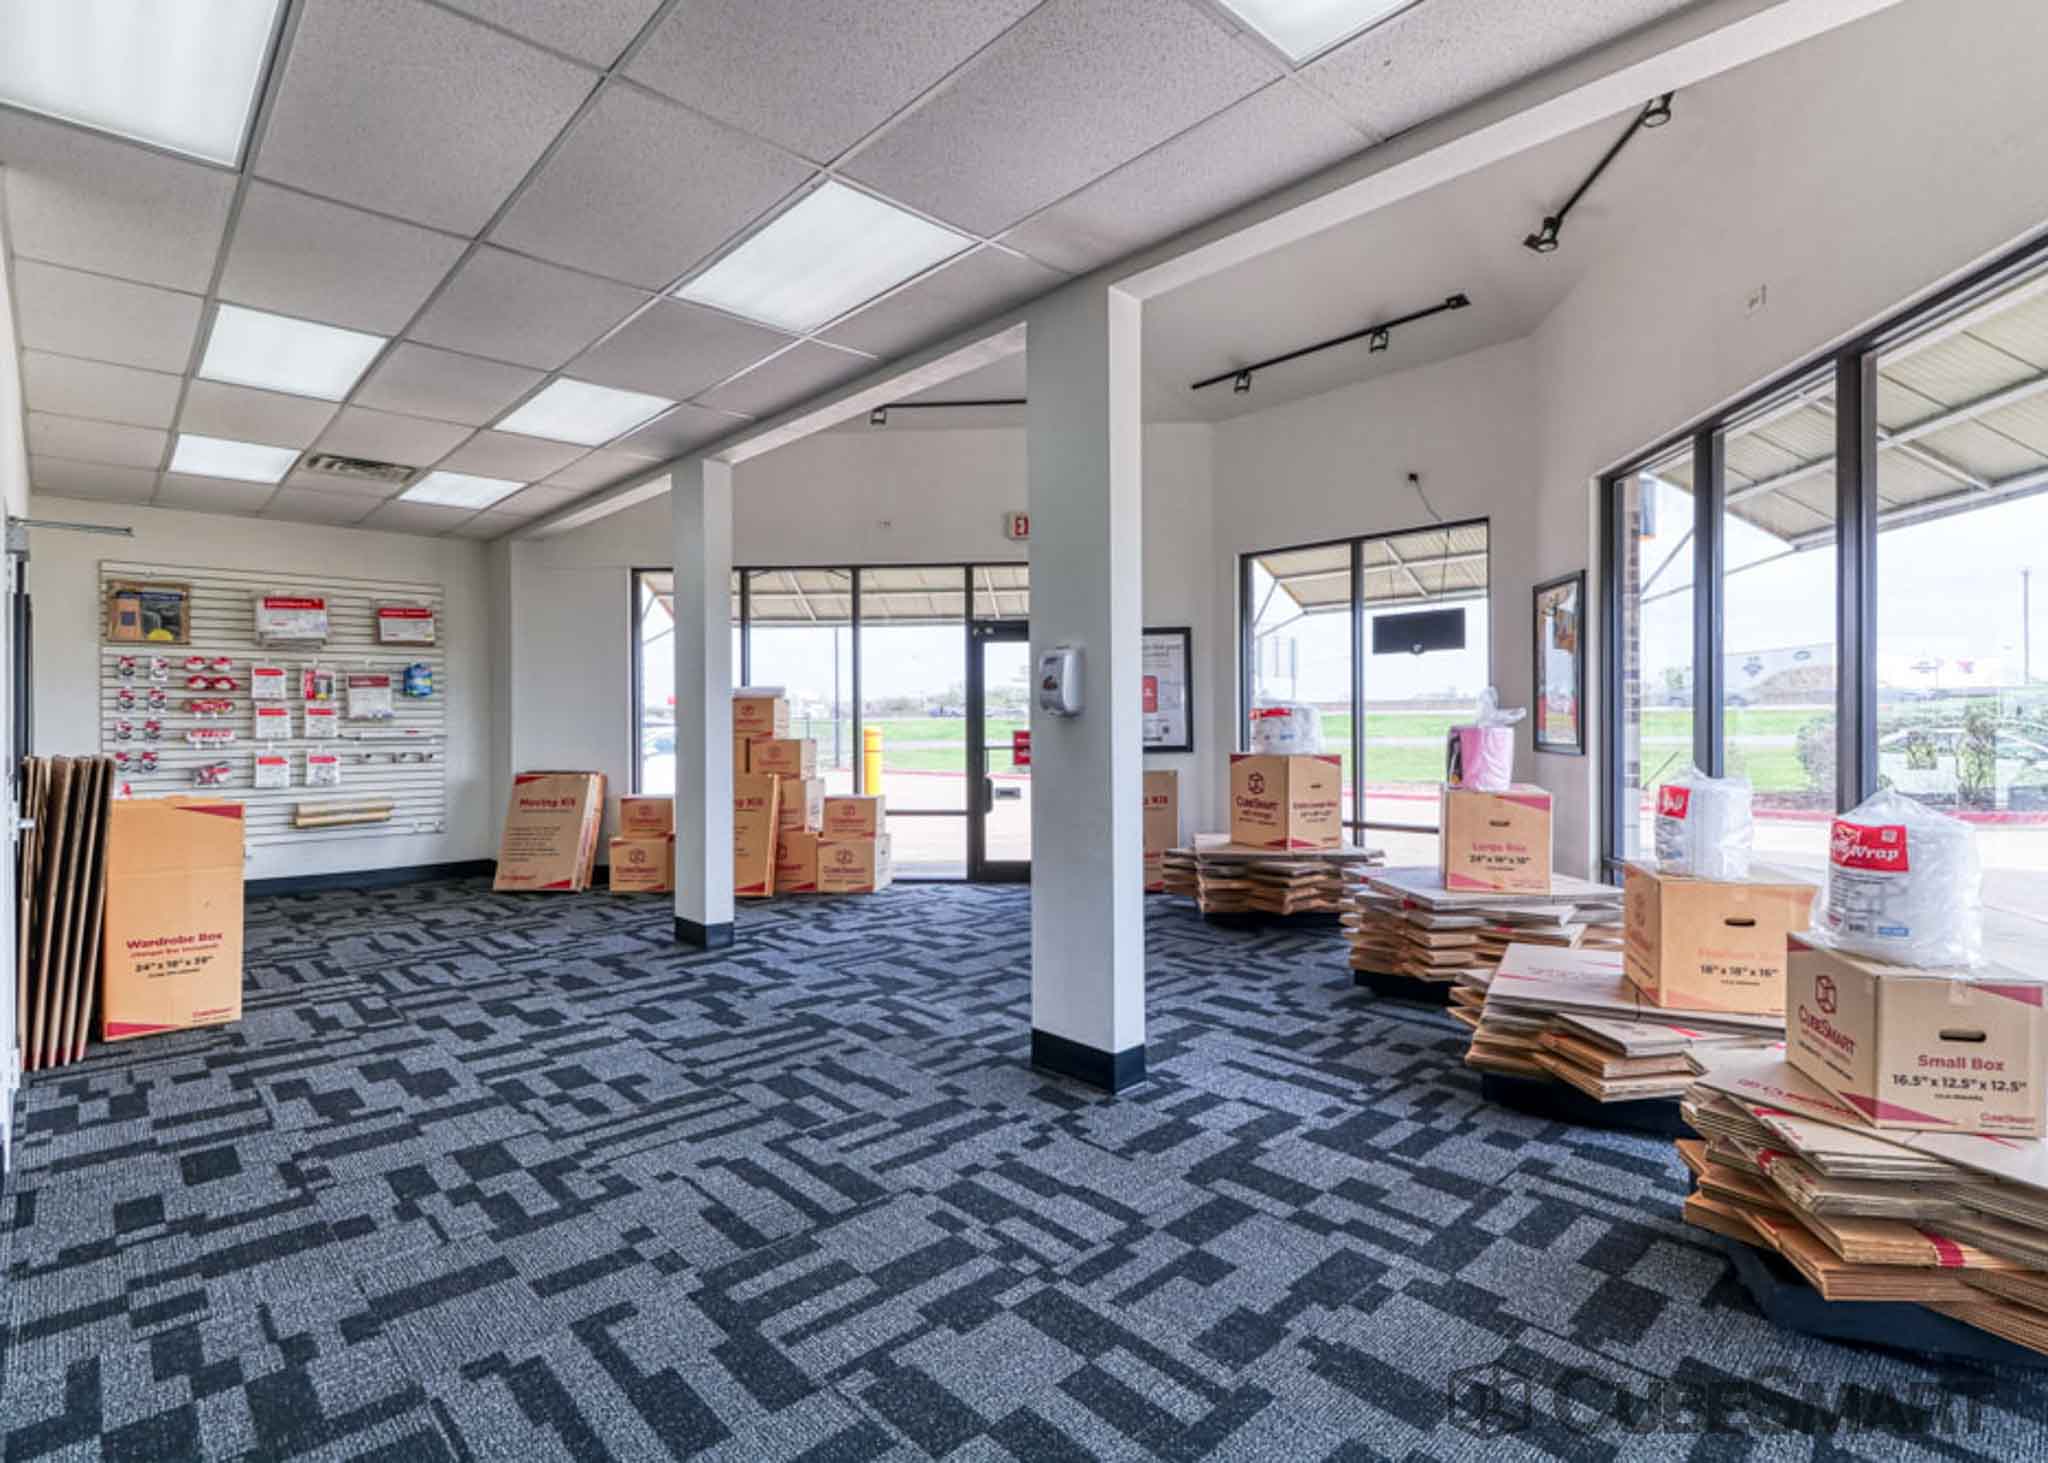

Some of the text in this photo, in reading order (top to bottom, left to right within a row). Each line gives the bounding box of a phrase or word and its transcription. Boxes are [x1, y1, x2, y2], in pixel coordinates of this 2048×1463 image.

[1918, 1054, 2005, 1072] Small Box
[1893, 1074, 1928, 1087] 16.5"
[1942, 1076, 1977, 1090] 12.5"
[1992, 1080, 2027, 1093] 12.5"
